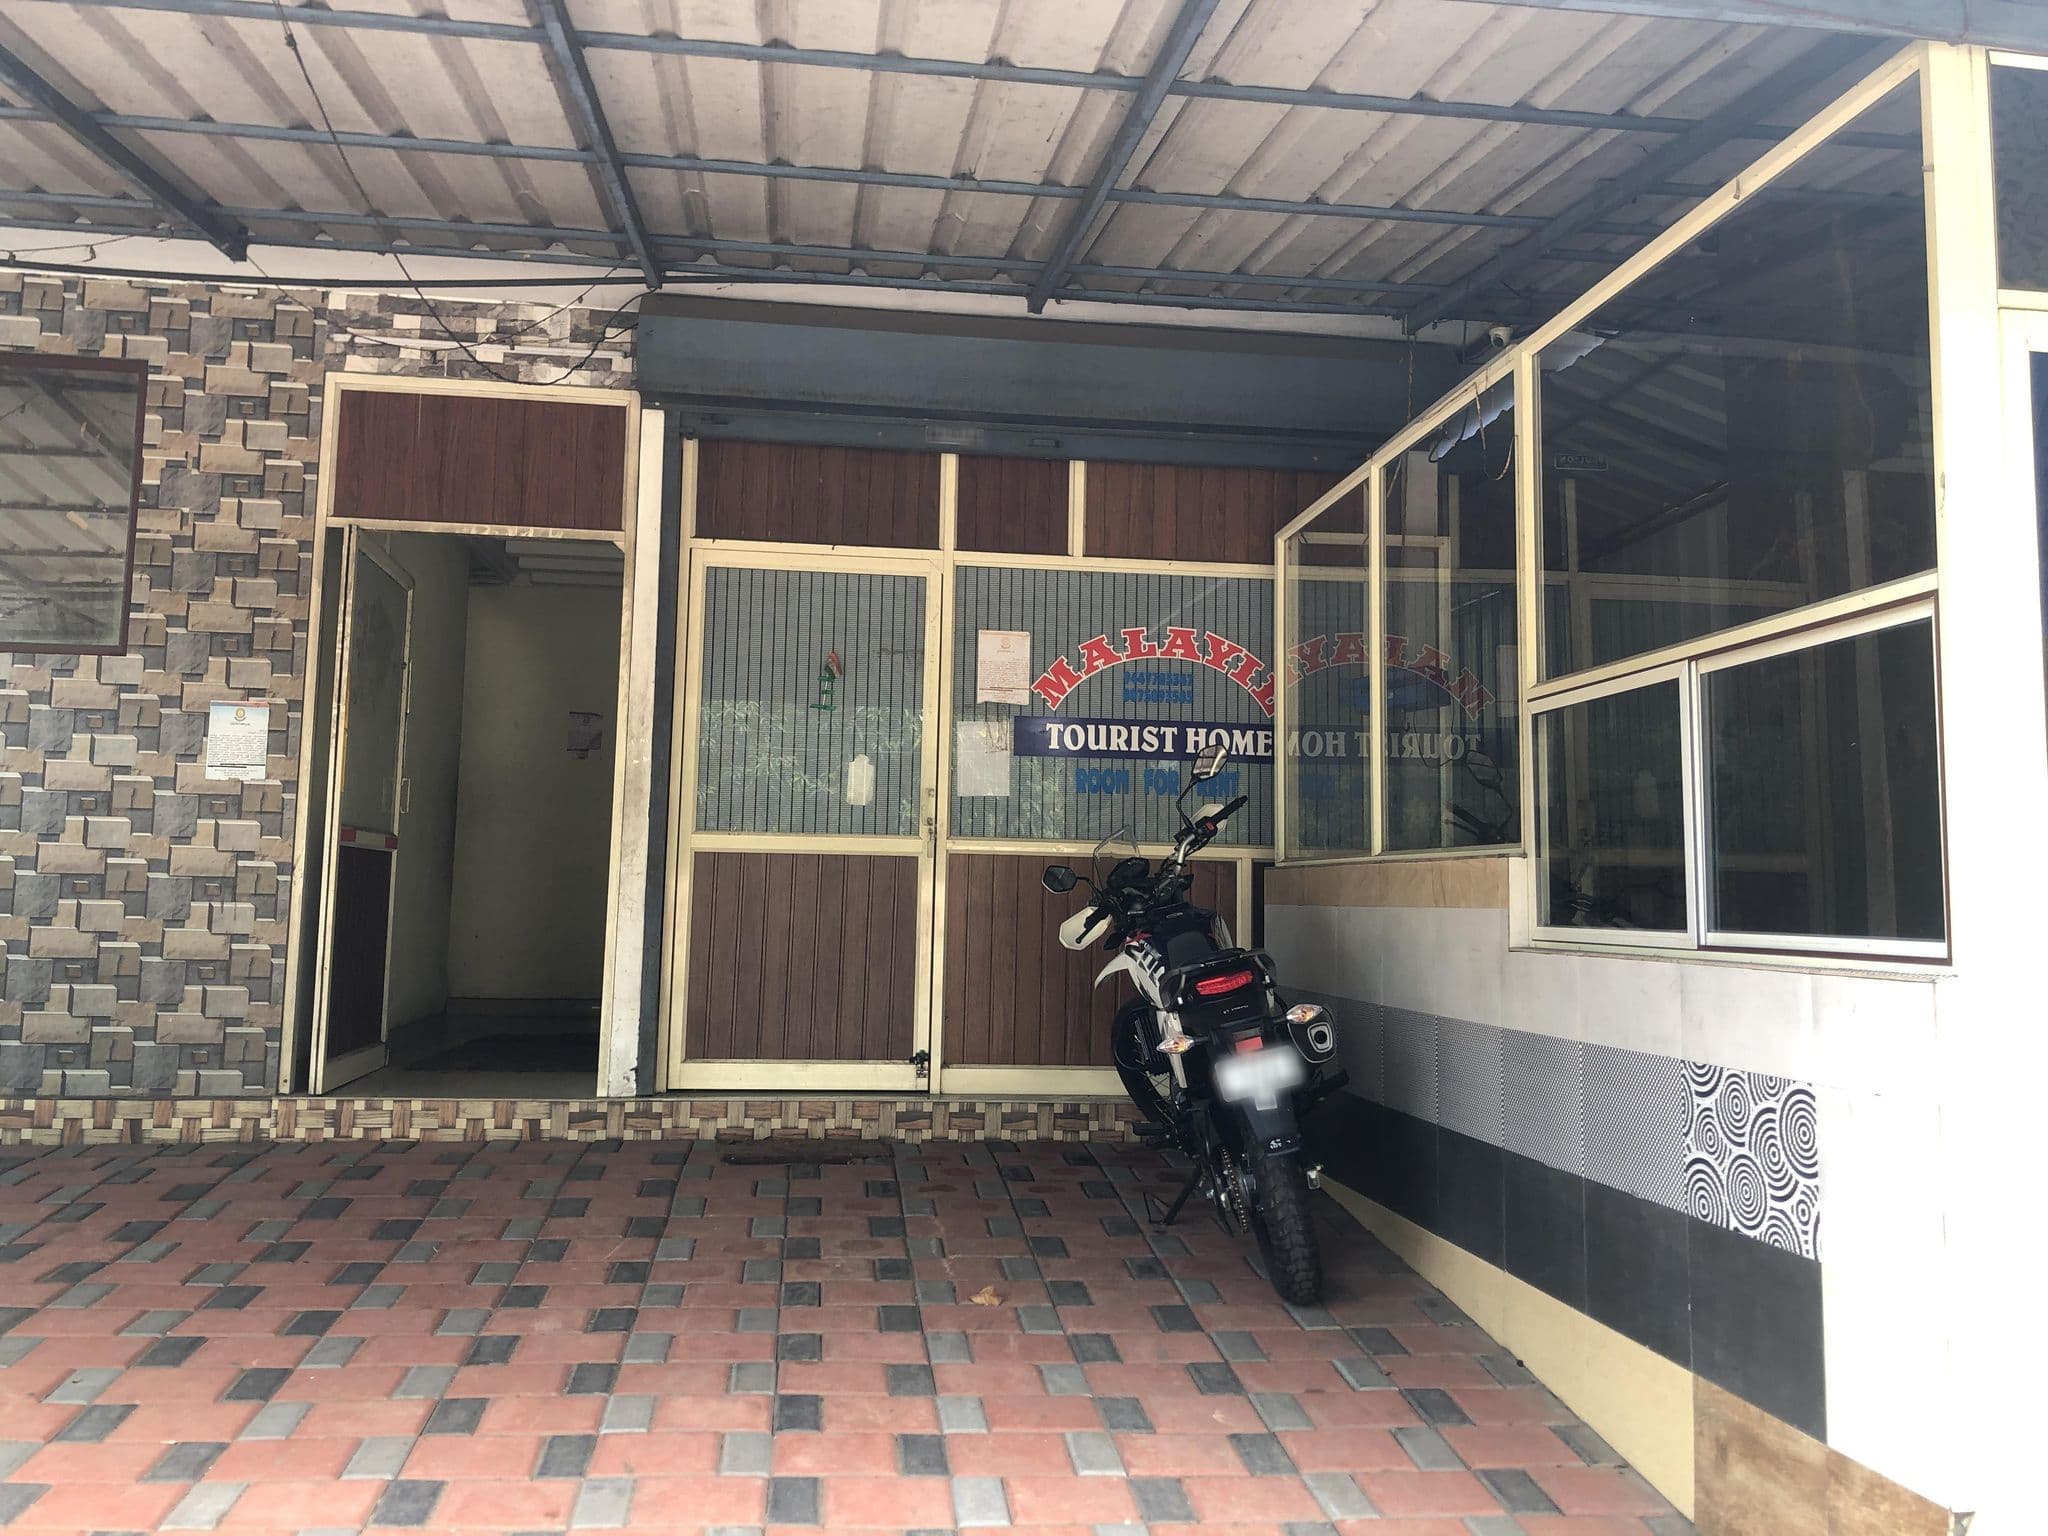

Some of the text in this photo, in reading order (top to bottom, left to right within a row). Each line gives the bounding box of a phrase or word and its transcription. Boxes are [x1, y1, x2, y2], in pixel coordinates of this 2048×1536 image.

[1046, 722, 1272, 757] TOURIST HOME
[1076, 768, 1130, 795] ROOM
[1144, 769, 1180, 796] FOR
